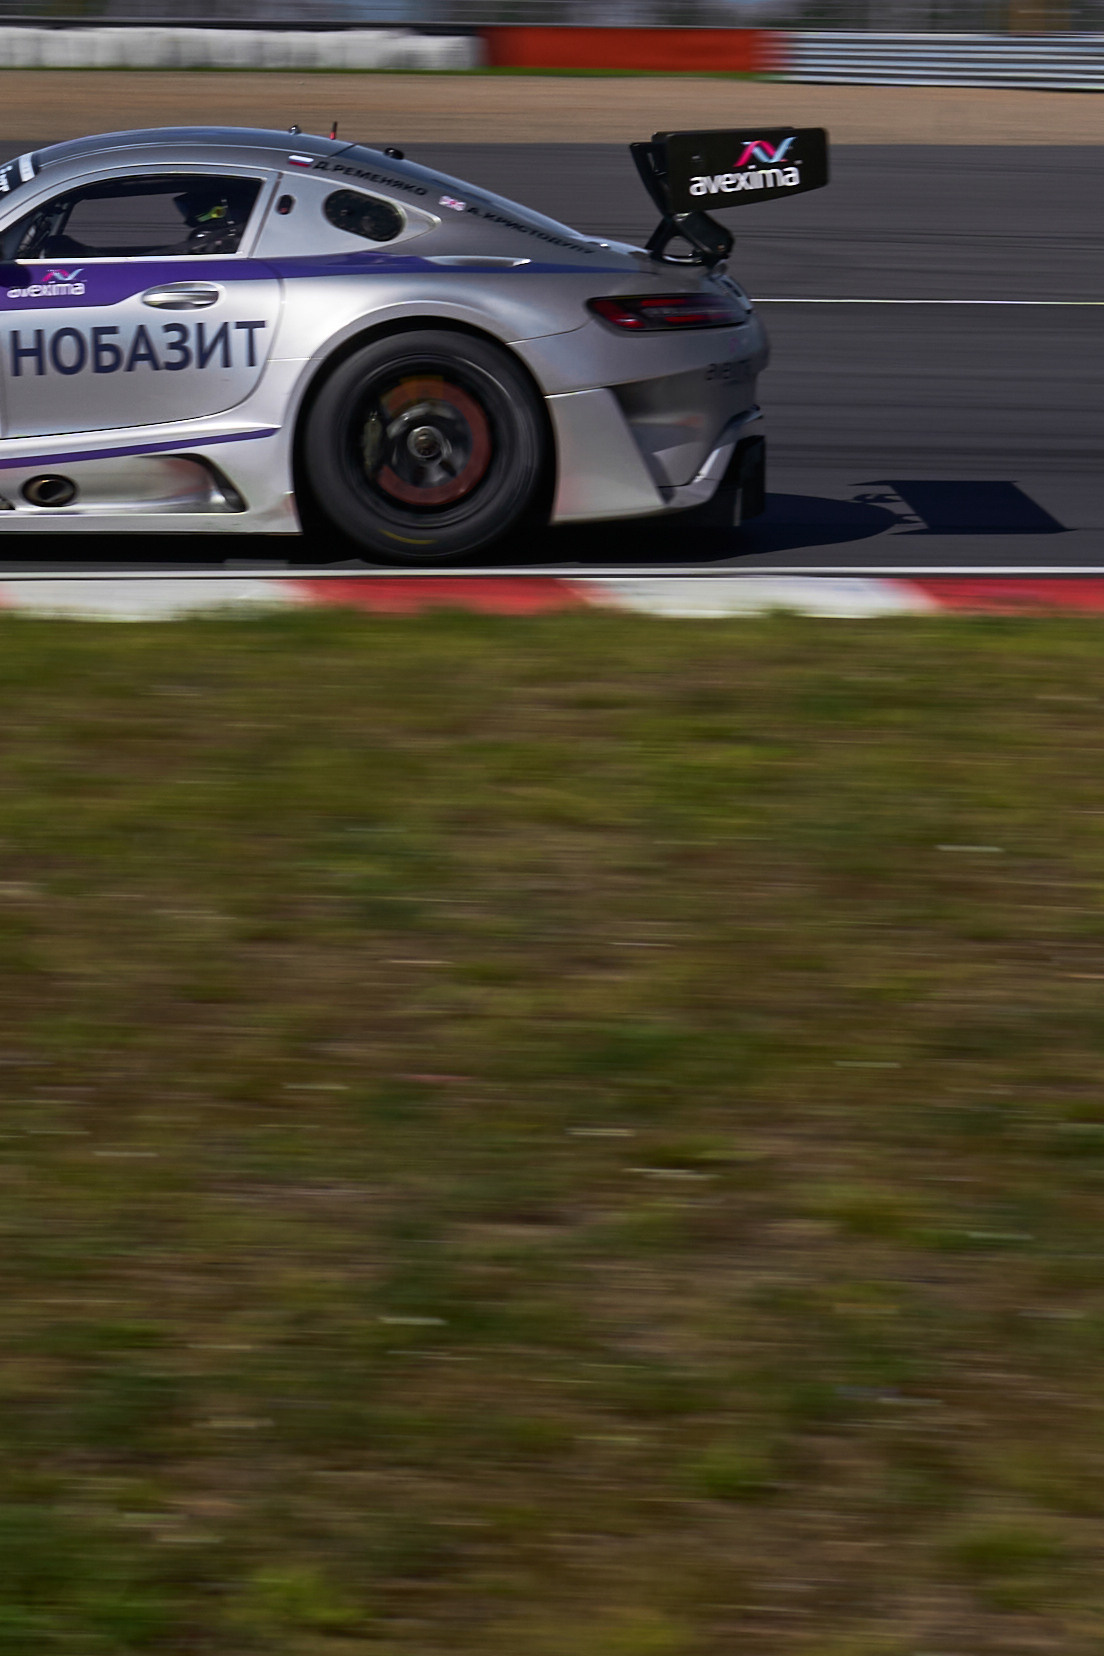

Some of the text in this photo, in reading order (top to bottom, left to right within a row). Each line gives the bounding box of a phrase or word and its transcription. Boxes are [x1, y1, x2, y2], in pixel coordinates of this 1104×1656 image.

[689, 164, 801, 196] avexima
[7, 281, 85, 299] avexima
[10, 320, 267, 377] НОБАЗИТ
